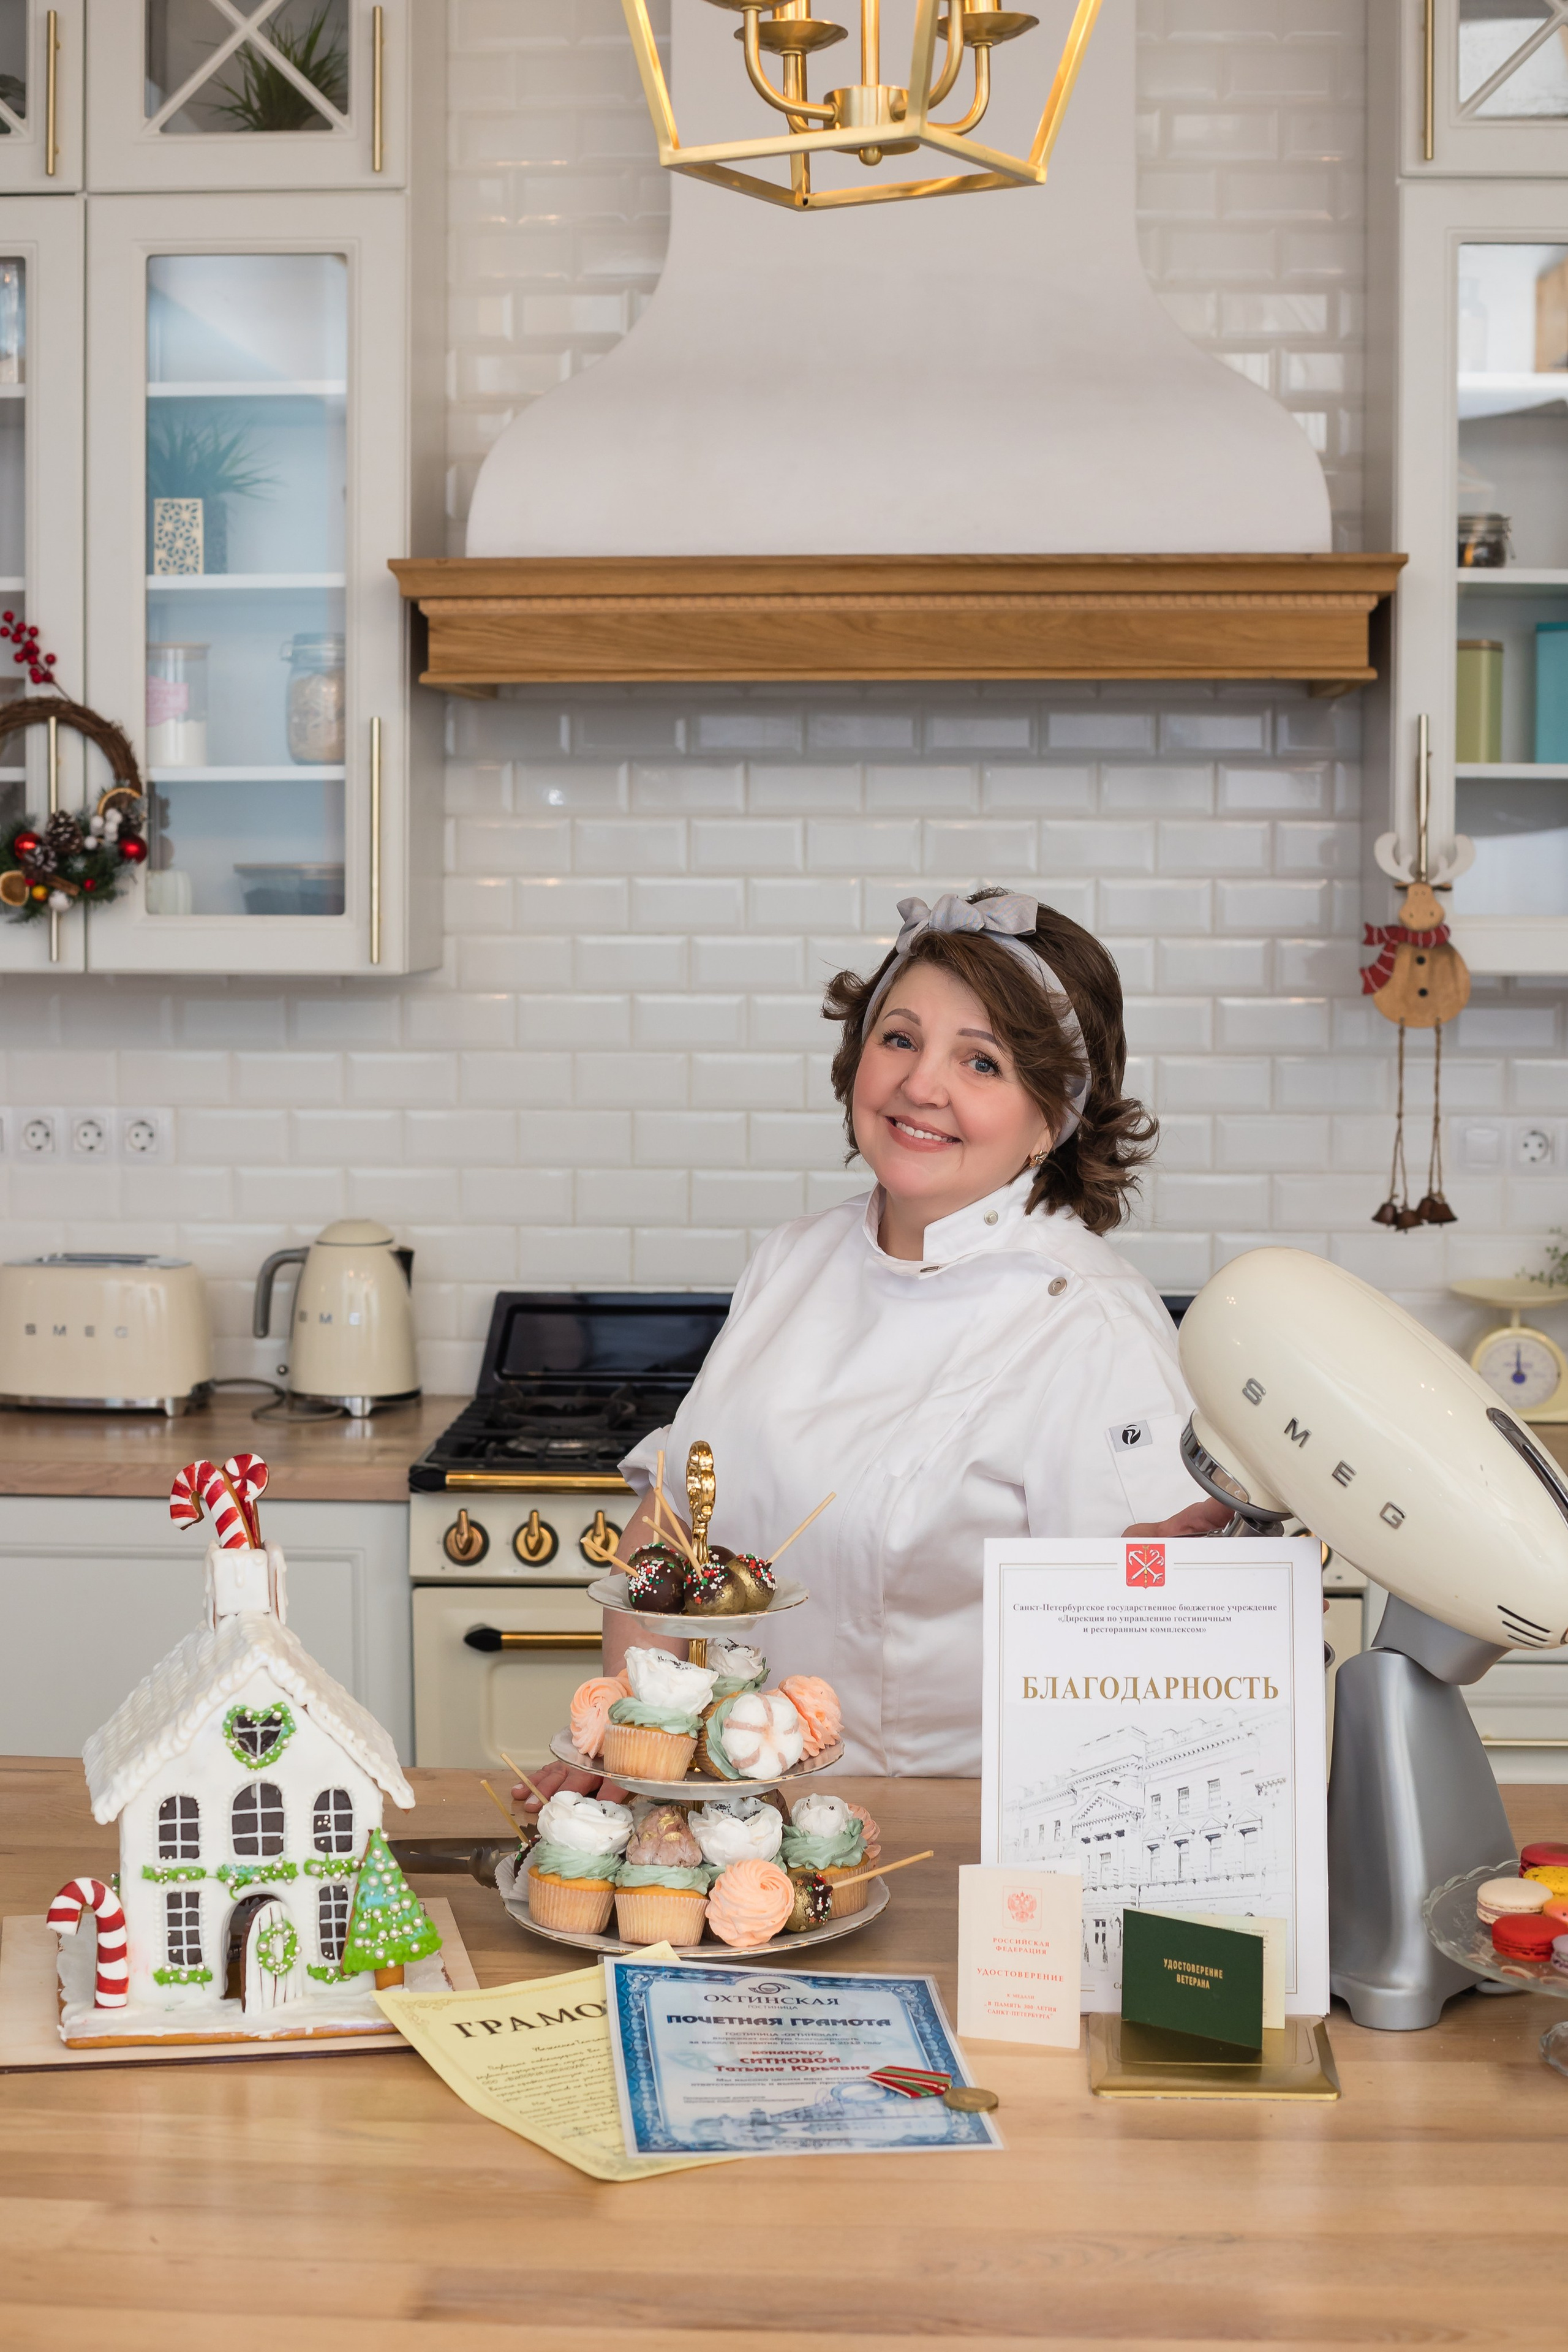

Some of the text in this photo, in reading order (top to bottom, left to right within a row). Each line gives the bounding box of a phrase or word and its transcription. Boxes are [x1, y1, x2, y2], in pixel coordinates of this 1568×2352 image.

[1242, 1378, 1406, 1529] SMEG
[1012, 1603, 1104, 1613] Санкт-Петербургское
[1178, 1604, 1225, 1612] бюджетное
[1058, 1615, 1104, 1624] «Дирекция
[1022, 1675, 1279, 1705] БЛАГОДАРНОСТЬ
[992, 1937, 1050, 1947] РОССИЙСКАЯ
[995, 1945, 1047, 1955] ФЕДЕРАЦИЯ
[976, 1967, 1065, 1982] УДОСТОВЕРЕНИЕ
[1163, 1958, 1223, 1980] УДОСТОВЕРЕНИЕ
[1176, 1973, 1210, 1989] ВЕТЕРАНА
[704, 1994, 839, 2005] ОХТИНСКАЯ
[450, 1999, 607, 2038] ГРАМО
[666, 2015, 892, 2027] ПОЧЕТНАЯ ГРАМОТА
[739, 2056, 842, 2065] СИТНОВОЙ
[791, 2064, 871, 2073] Юрьевне
